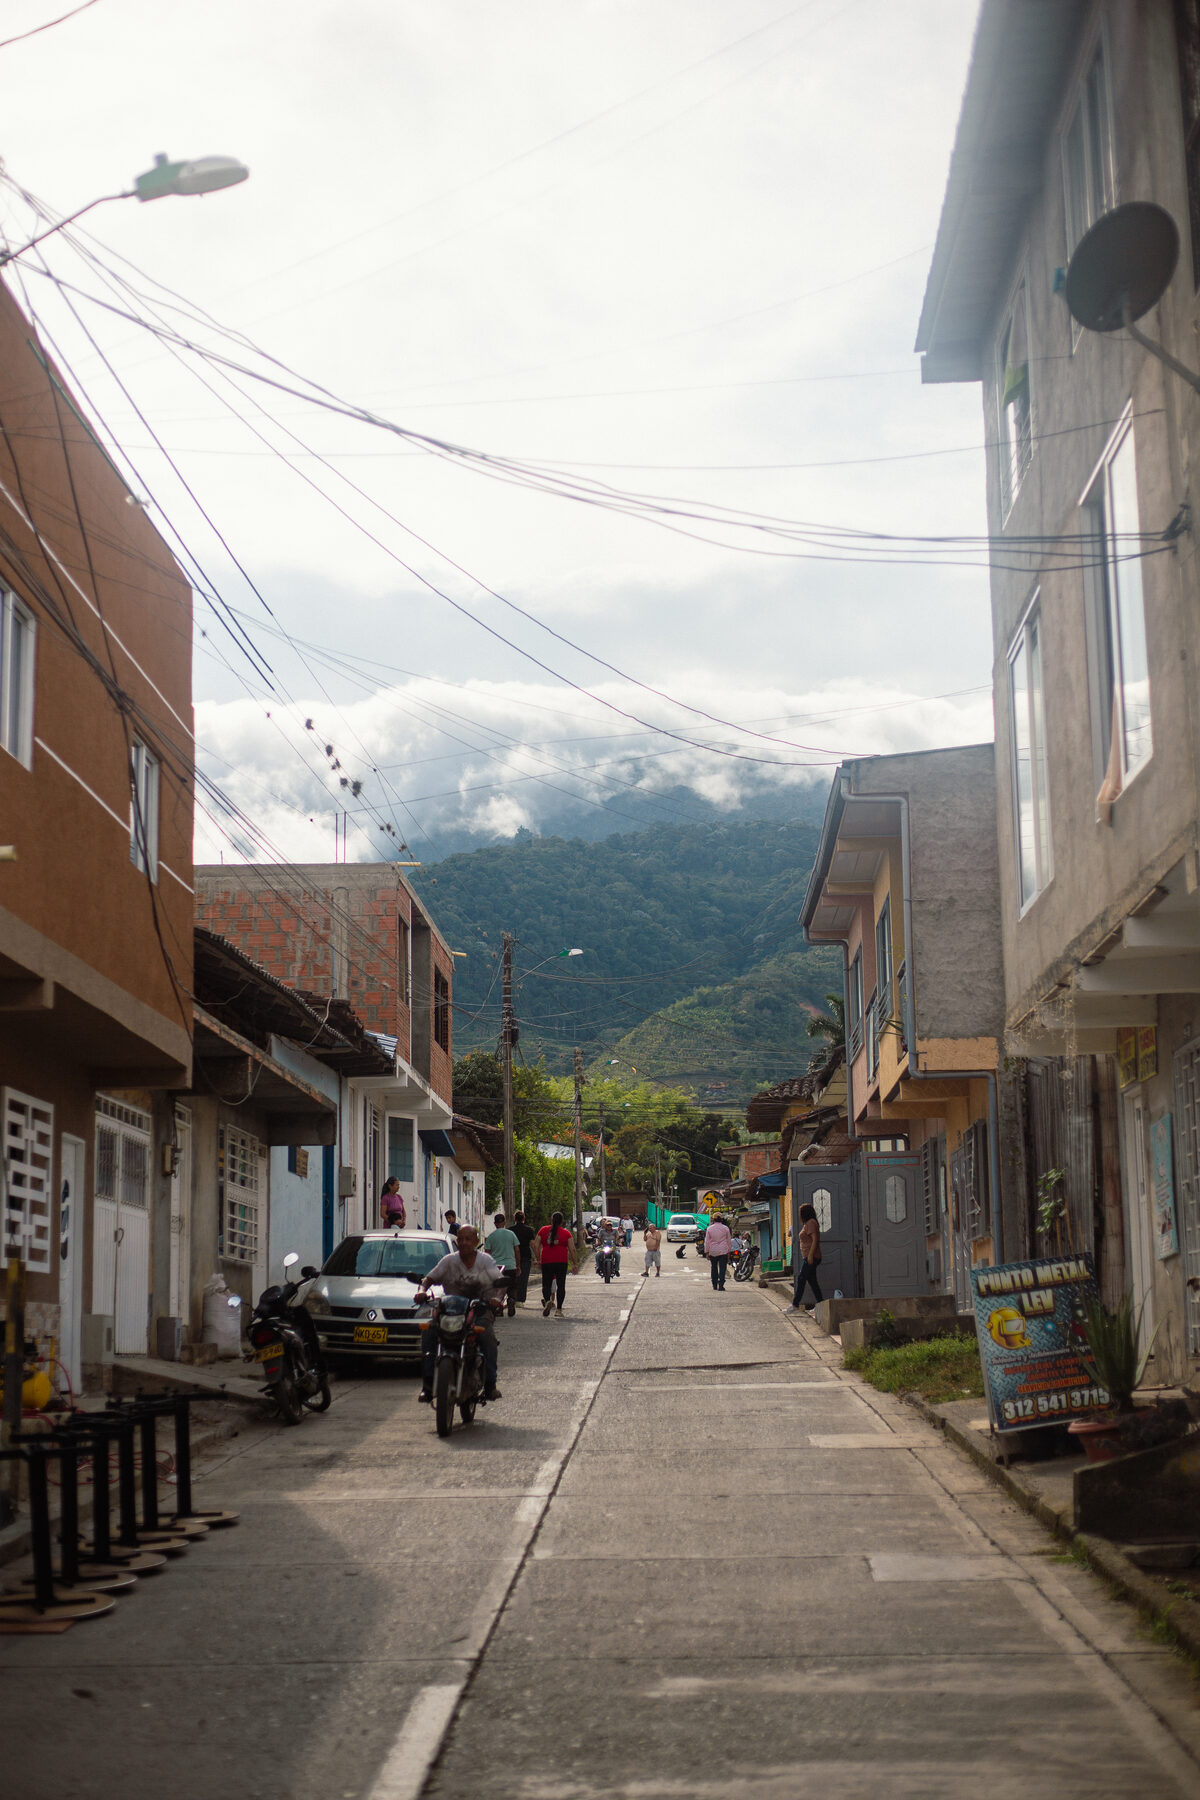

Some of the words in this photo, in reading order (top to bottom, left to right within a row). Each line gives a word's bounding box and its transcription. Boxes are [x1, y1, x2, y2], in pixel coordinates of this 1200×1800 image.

[977, 1268, 1035, 1296] PUNTO
[1036, 1259, 1090, 1287] METAL
[1021, 1289, 1055, 1317] LEV
[1003, 1398, 1035, 1421] 312
[1037, 1392, 1068, 1414] 541
[1070, 1387, 1111, 1408] 3715
